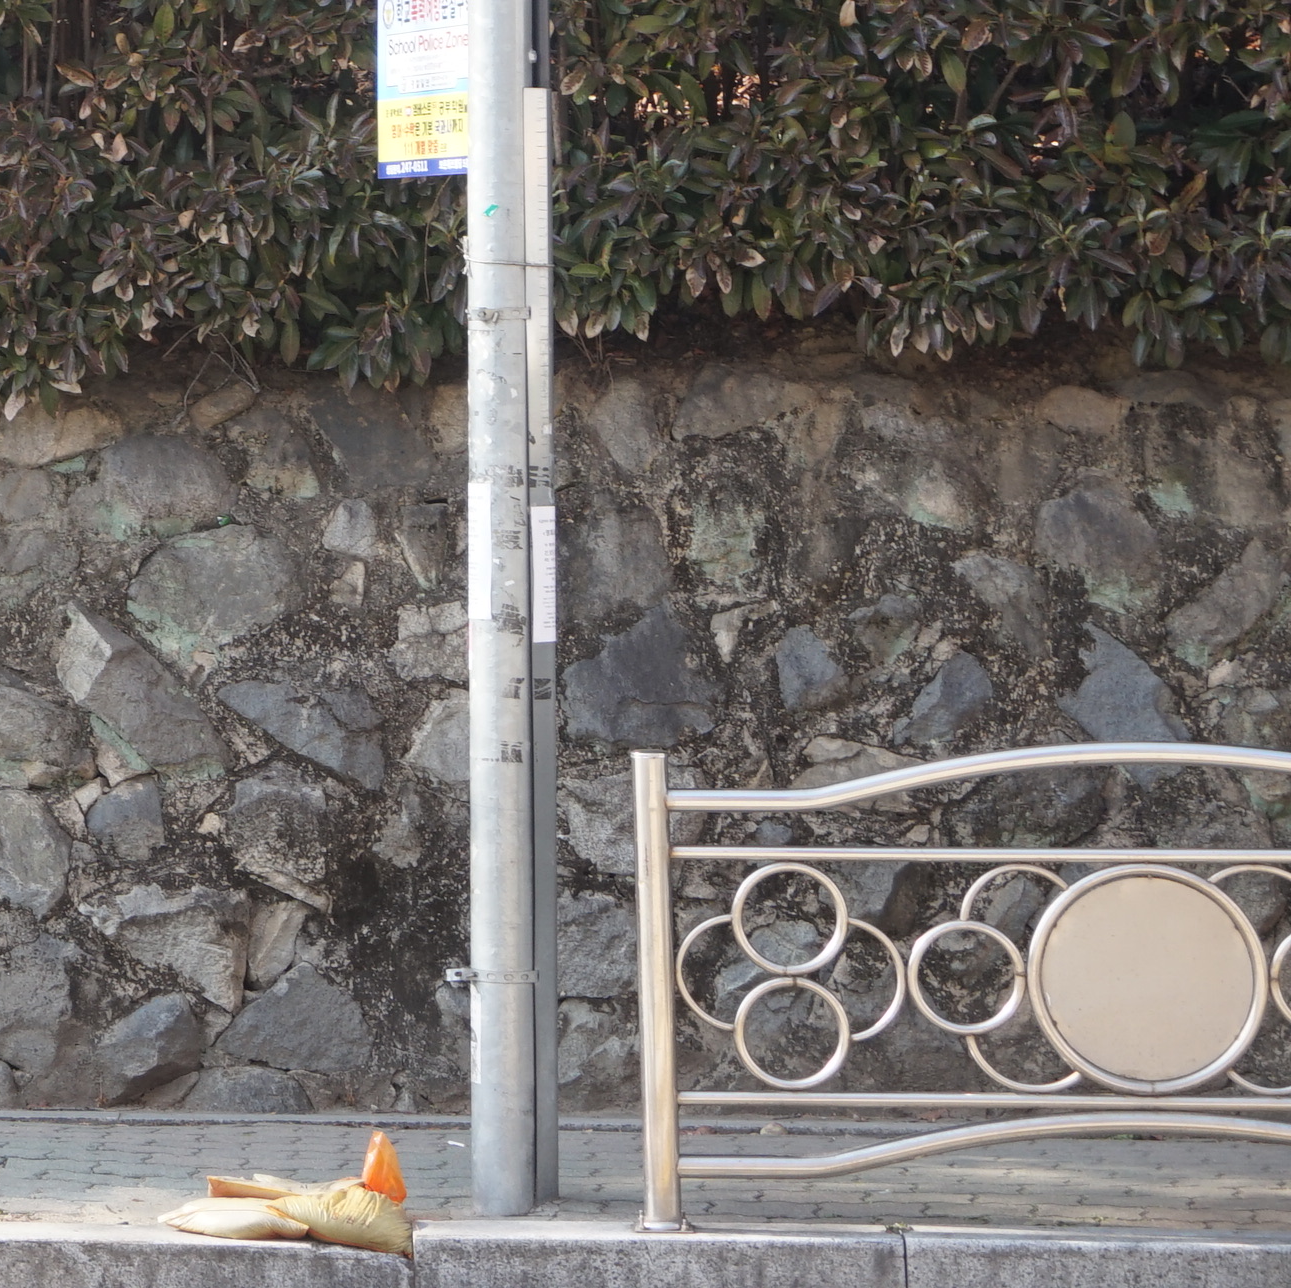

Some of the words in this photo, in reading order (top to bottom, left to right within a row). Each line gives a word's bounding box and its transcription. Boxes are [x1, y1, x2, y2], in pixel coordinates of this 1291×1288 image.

[388, 36, 416, 56] School
[418, 33, 443, 53] Police
[446, 31, 468, 49] Zone
